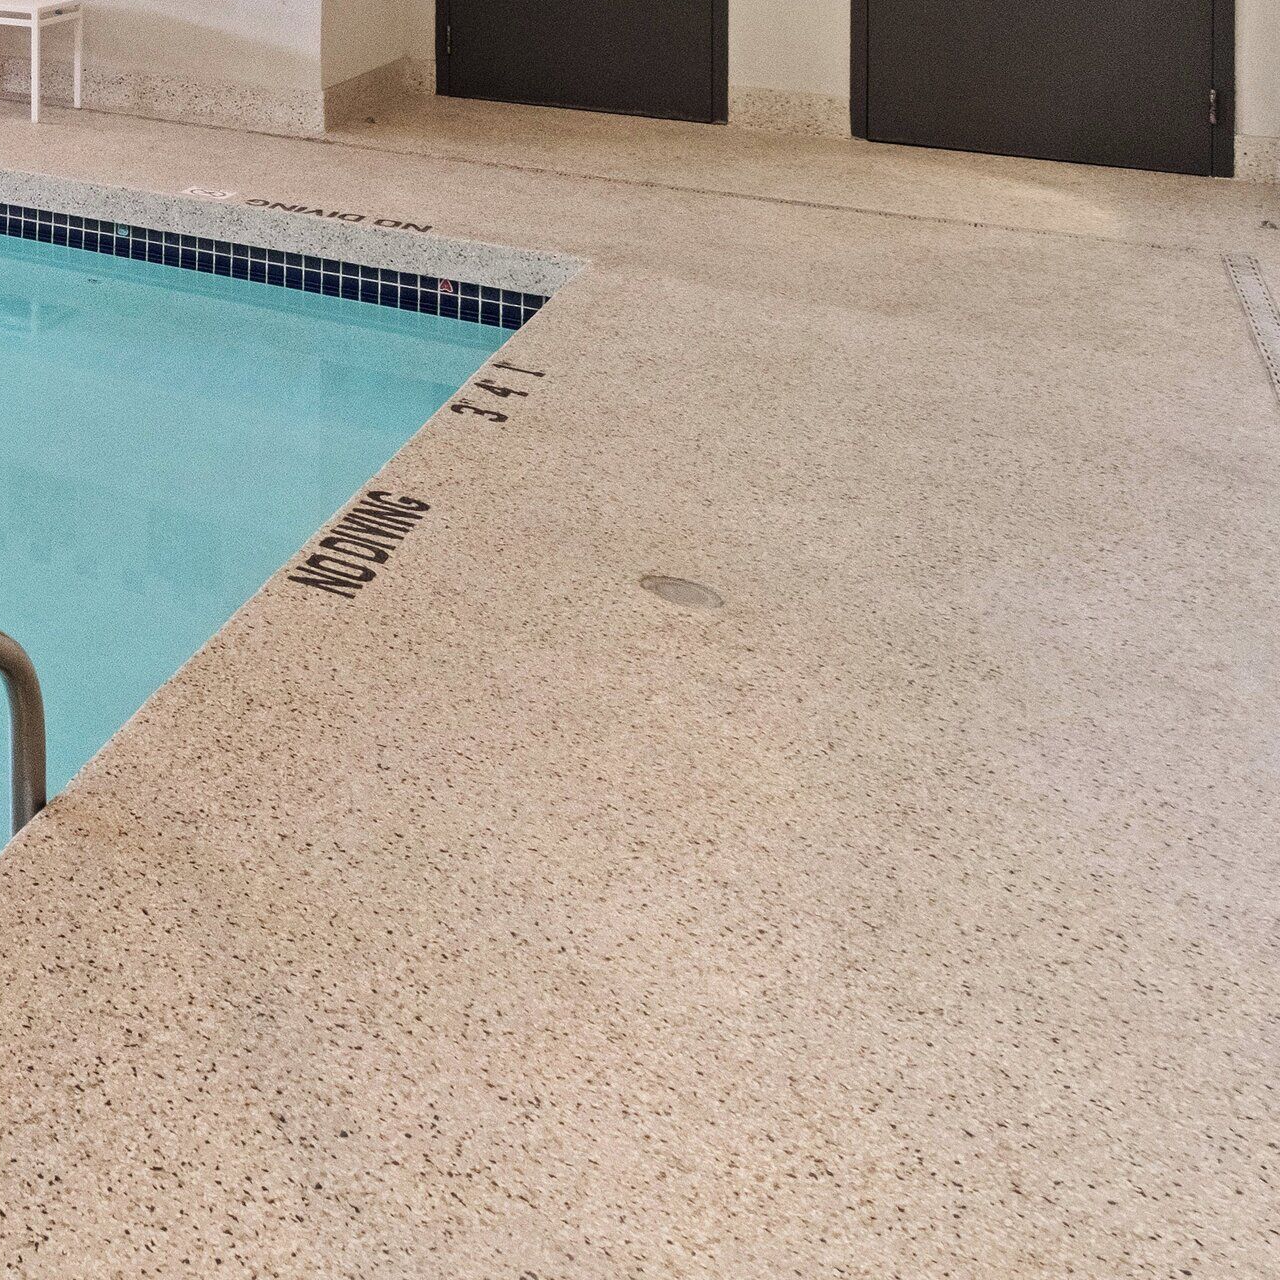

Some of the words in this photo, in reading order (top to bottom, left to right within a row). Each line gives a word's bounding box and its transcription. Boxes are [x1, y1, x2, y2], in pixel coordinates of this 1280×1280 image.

[244, 198, 366, 222] DIVING
[373, 219, 433, 233] NO
[319, 490, 431, 564] DIVING
[288, 553, 377, 599] NO
